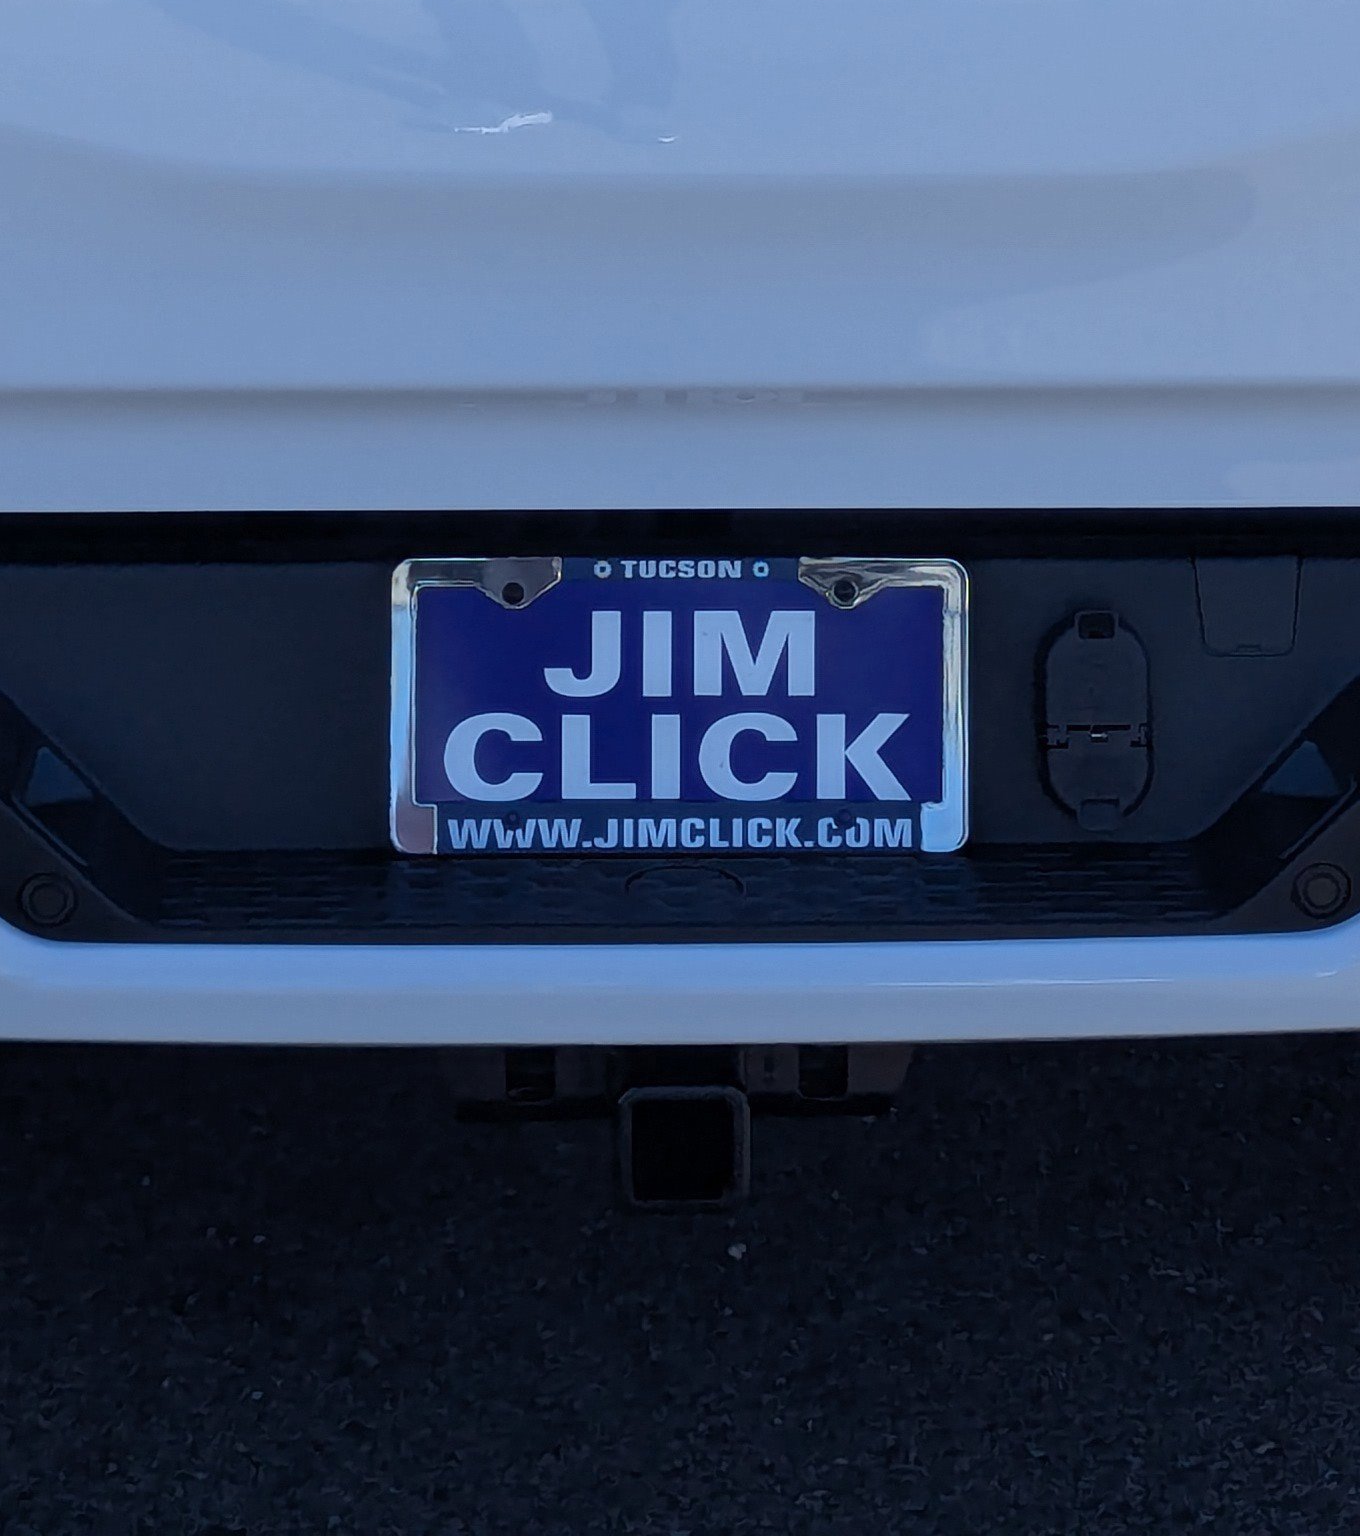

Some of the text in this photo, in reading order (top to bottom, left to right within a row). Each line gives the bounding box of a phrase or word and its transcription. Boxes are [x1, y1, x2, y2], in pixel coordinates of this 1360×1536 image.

[620, 559, 742, 579] TUCSON
[543, 609, 816, 698] JIM
[443, 711, 912, 801] CLICK
[447, 817, 913, 849] WWW.JIMCLICK.COM
